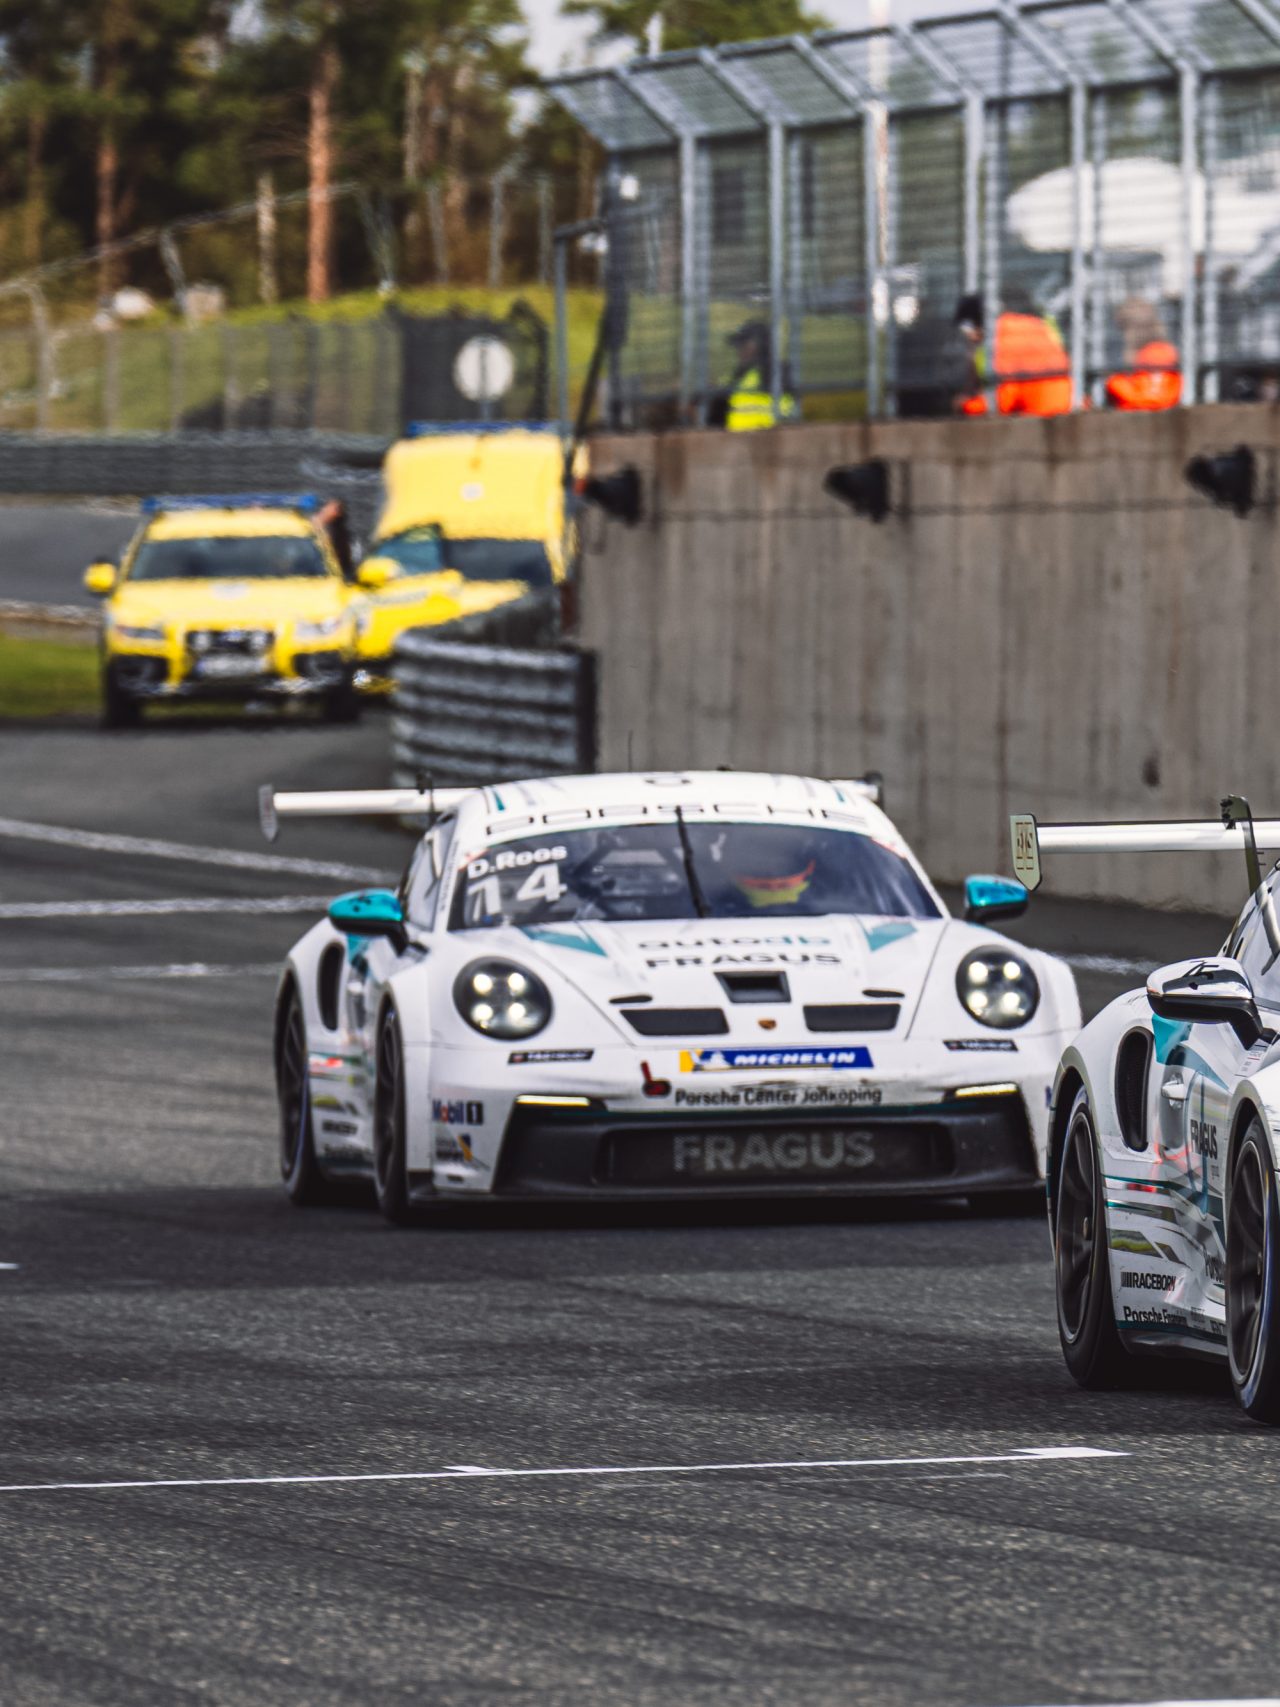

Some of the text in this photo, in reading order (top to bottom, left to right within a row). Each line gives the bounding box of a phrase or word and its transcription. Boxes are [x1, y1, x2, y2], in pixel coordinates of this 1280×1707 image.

[467, 846, 568, 880] D.Roos
[467, 863, 568, 929] 14
[645, 954, 842, 968] FRAGUS
[734, 1051, 856, 1066] MICHELIN
[675, 1088, 740, 1106] Porsche
[744, 1087, 797, 1104] Center
[673, 1131, 876, 1172] FRAGUS
[1122, 1304, 1162, 1323] Porsche
